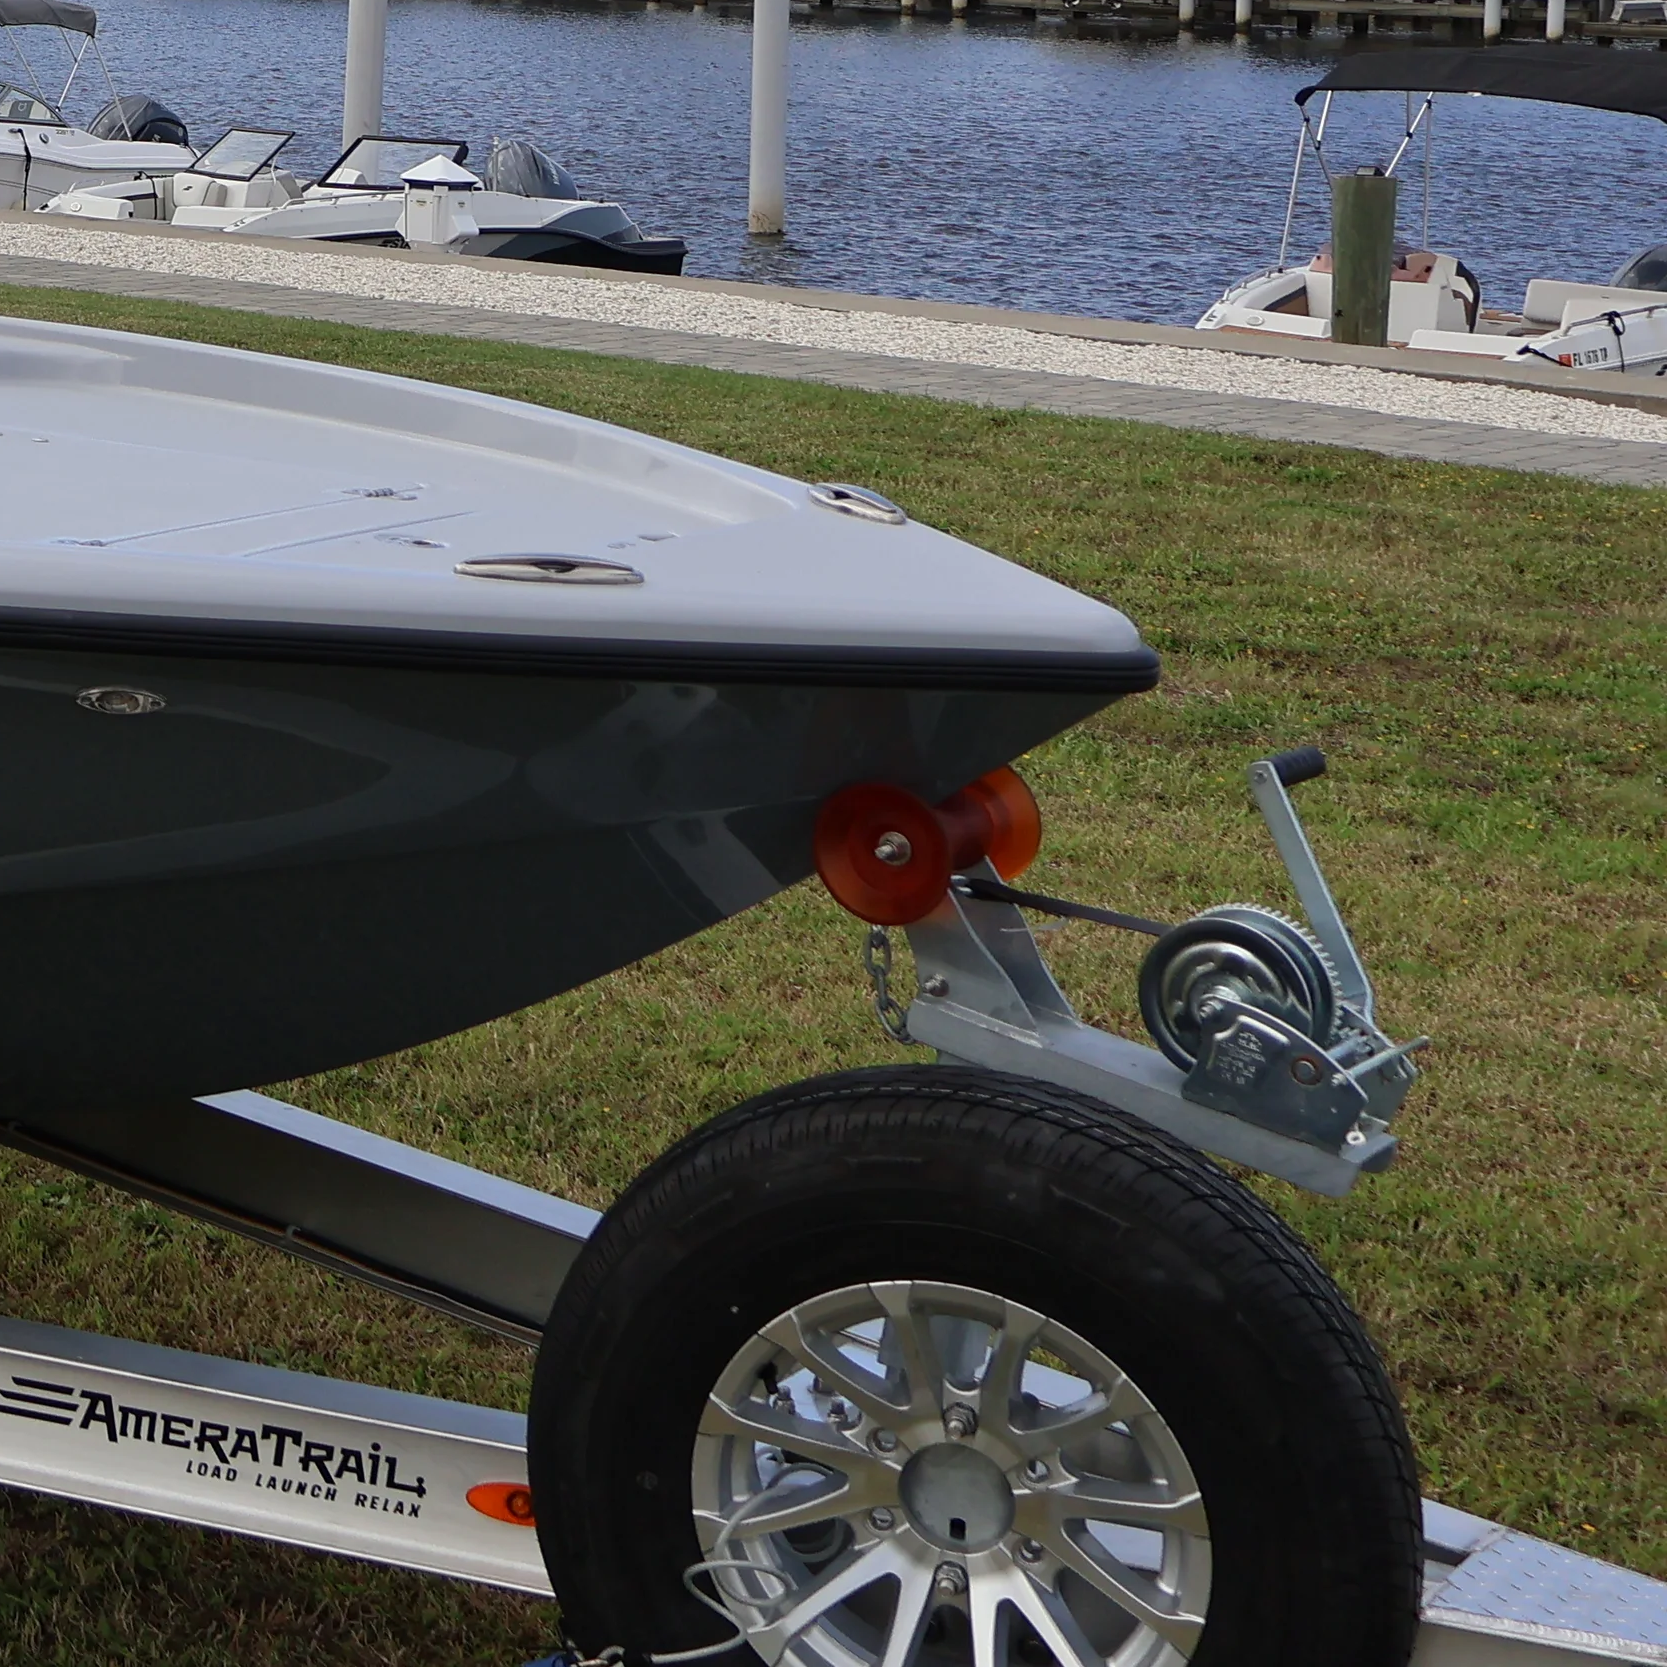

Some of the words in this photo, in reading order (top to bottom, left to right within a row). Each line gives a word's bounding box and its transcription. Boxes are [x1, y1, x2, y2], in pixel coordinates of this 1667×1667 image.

[185, 1459, 239, 1483] LOAD
[254, 1472, 338, 1502] LAUNCH
[354, 1492, 422, 1519] RELAX
